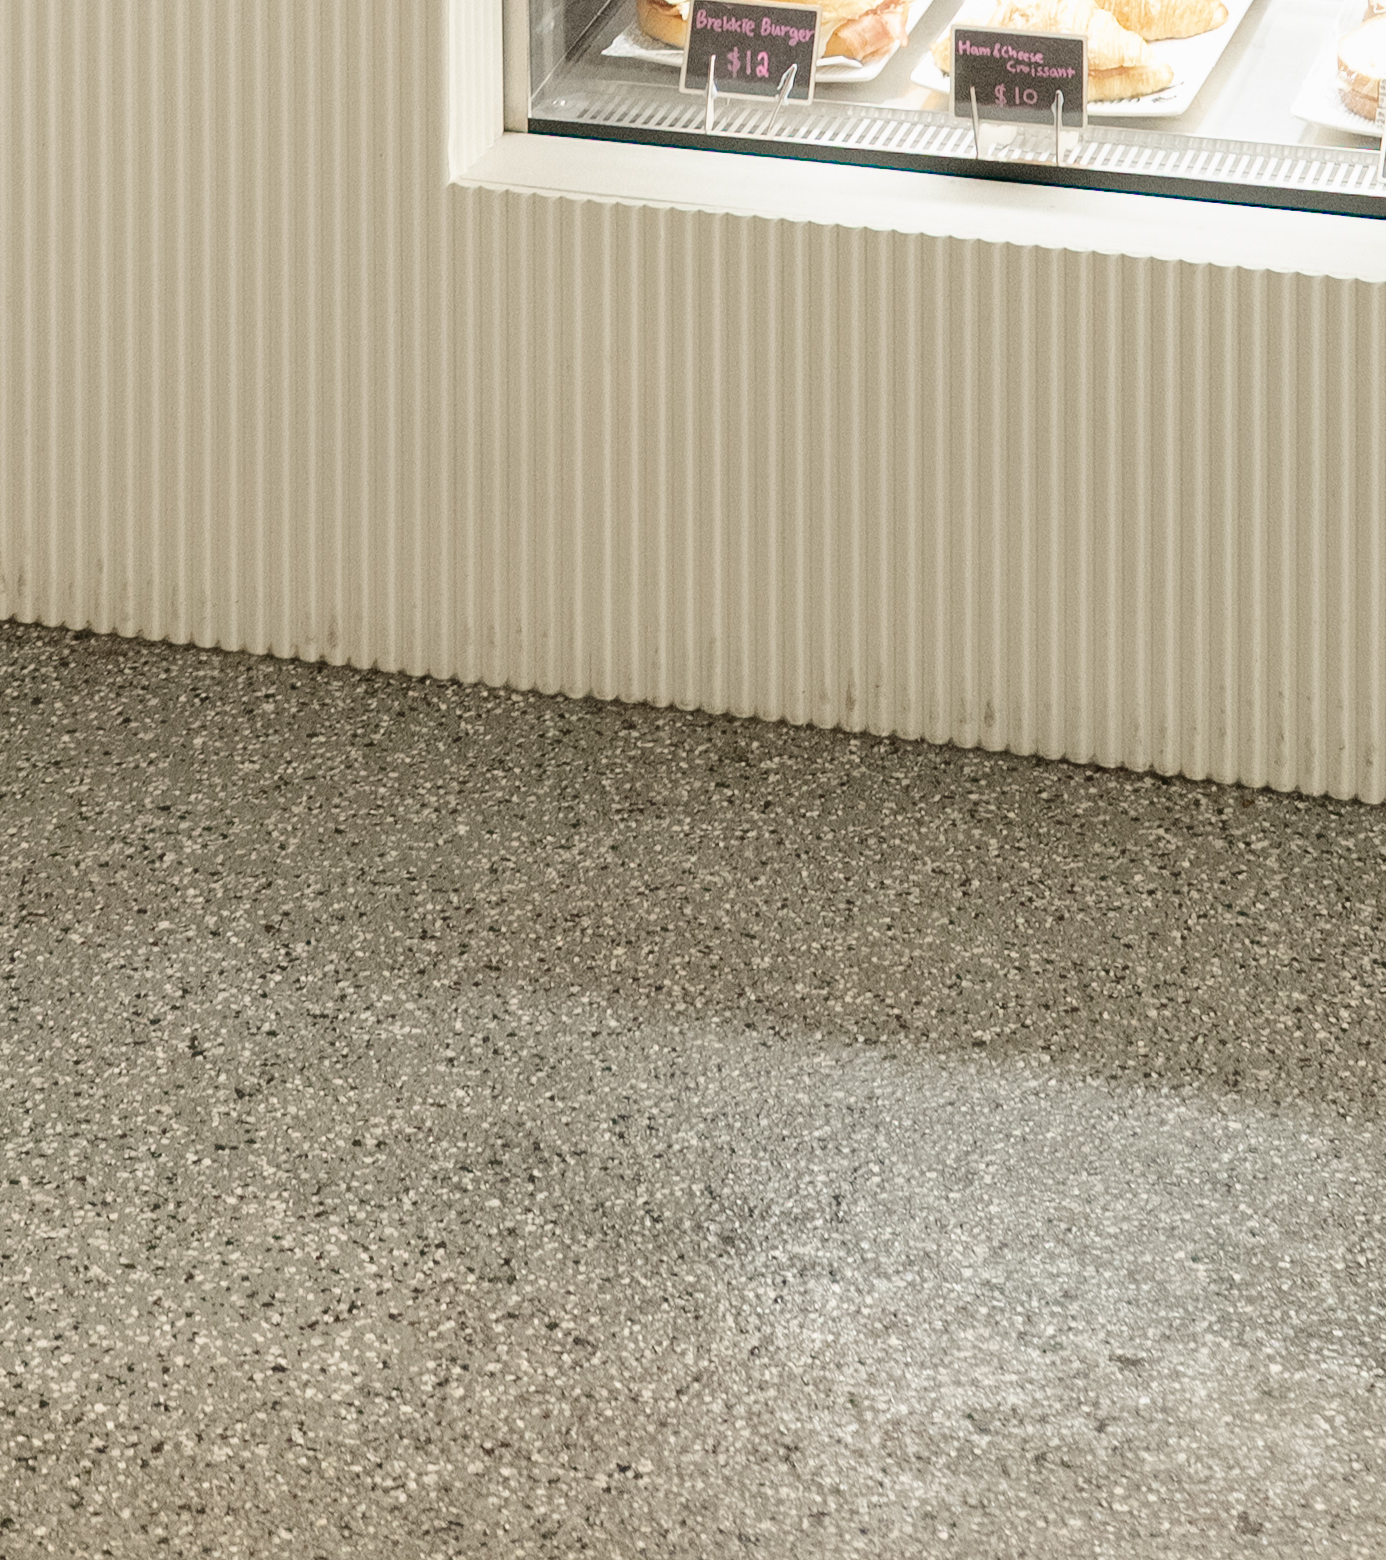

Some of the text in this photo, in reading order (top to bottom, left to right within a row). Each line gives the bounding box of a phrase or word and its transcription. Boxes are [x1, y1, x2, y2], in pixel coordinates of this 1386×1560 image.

[696, 9, 815, 46] Brekkie Burger
[727, 46, 769, 78] $12
[1006, 61, 1076, 79] Croissant
[994, 83, 1038, 108] $10
